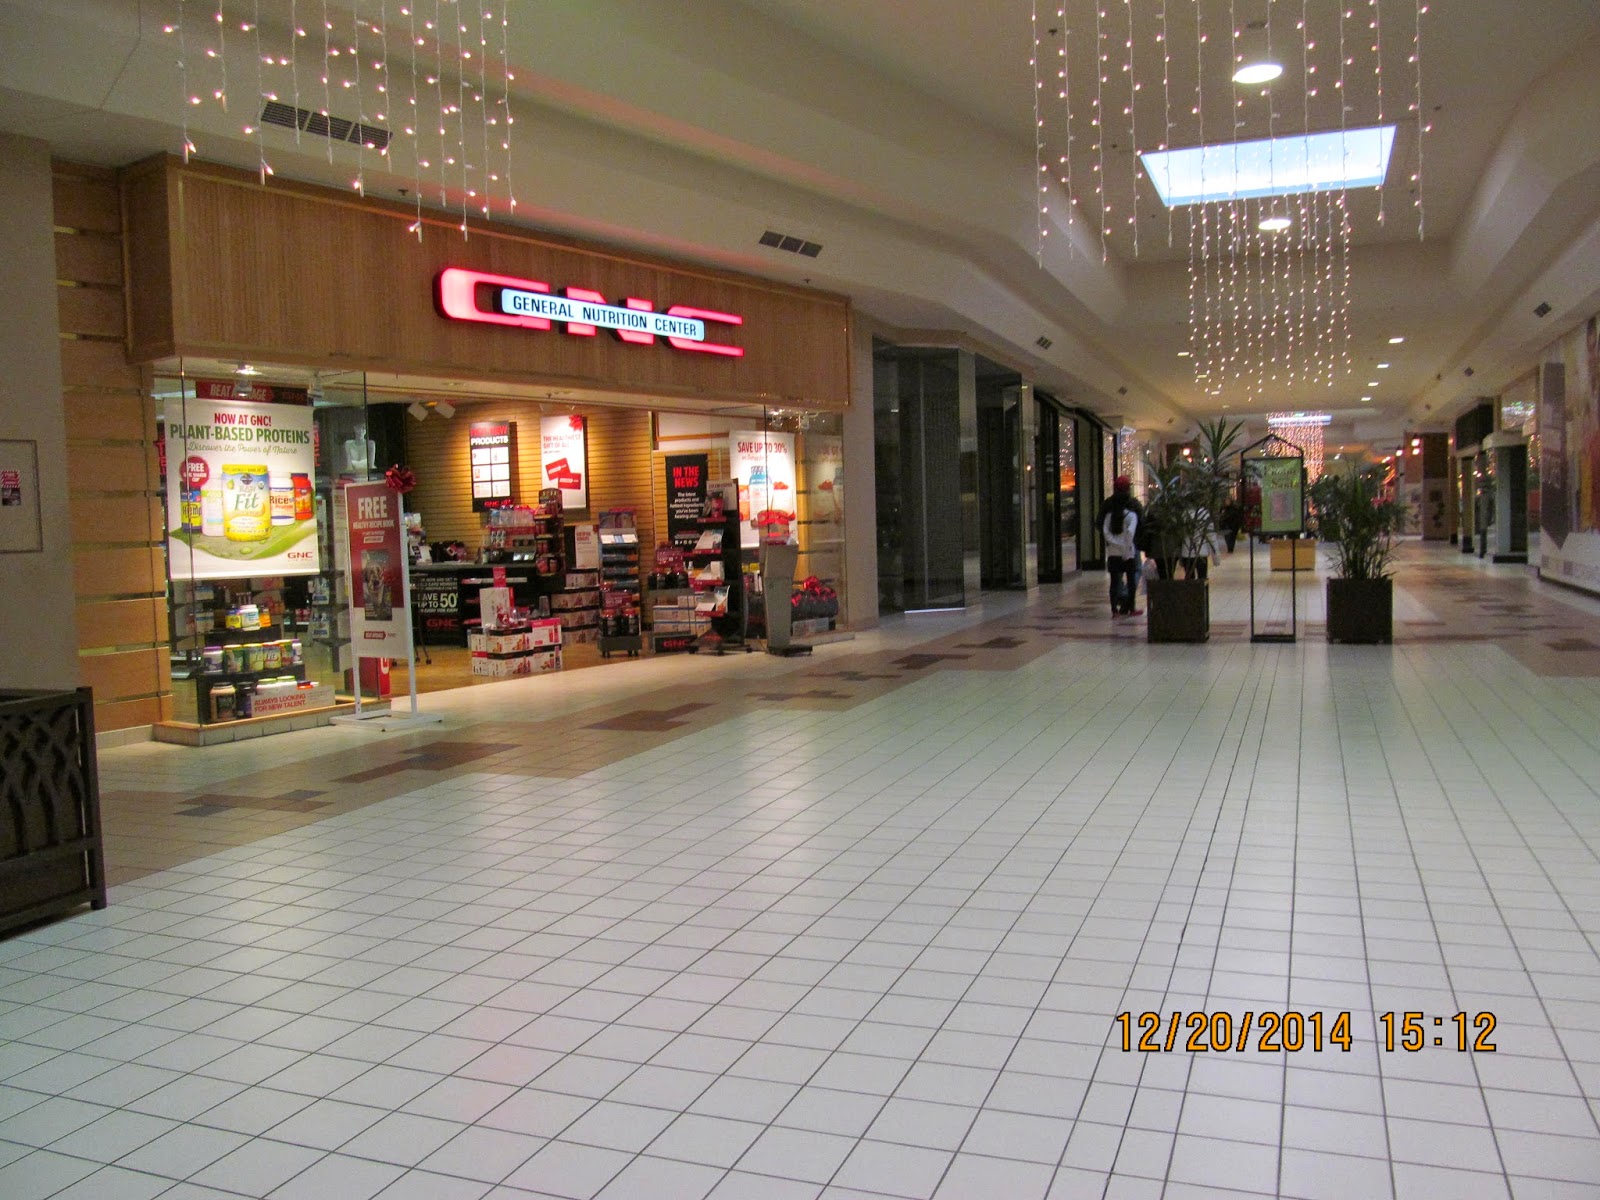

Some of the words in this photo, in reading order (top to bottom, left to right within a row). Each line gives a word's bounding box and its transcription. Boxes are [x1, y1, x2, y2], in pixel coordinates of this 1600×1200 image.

[512, 295, 575, 318] GENERAL
[582, 307, 648, 329] NUTRITION
[654, 318, 697, 336] CENTER
[210, 384, 231, 397] BEAT
[214, 413, 236, 424] NOW
[238, 414, 249, 425] AT
[251, 415, 272, 426] GNC!
[170, 424, 253, 441] PLANT-BASED
[256, 430, 310, 444] PROTEINS
[470, 436, 509, 445] PRODUCTS
[187, 442, 222, 452] Discover
[224, 443, 236, 452] the
[237, 444, 261, 453] Power
[262, 445, 272, 457] of
[273, 446, 298, 455] Nature
[737, 441, 753, 453] SAVE
[754, 442, 763, 453] UP
[764, 442, 773, 453] TO
[188, 463, 204, 472] FREE
[673, 467, 682, 478] IN
[684, 466, 699, 477] THE
[674, 477, 699, 489] NEWS
[234, 493, 260, 511] Fit
[270, 496, 289, 504] Rice
[358, 496, 388, 519] FREE
[279, 694, 305, 702] LOOKING
